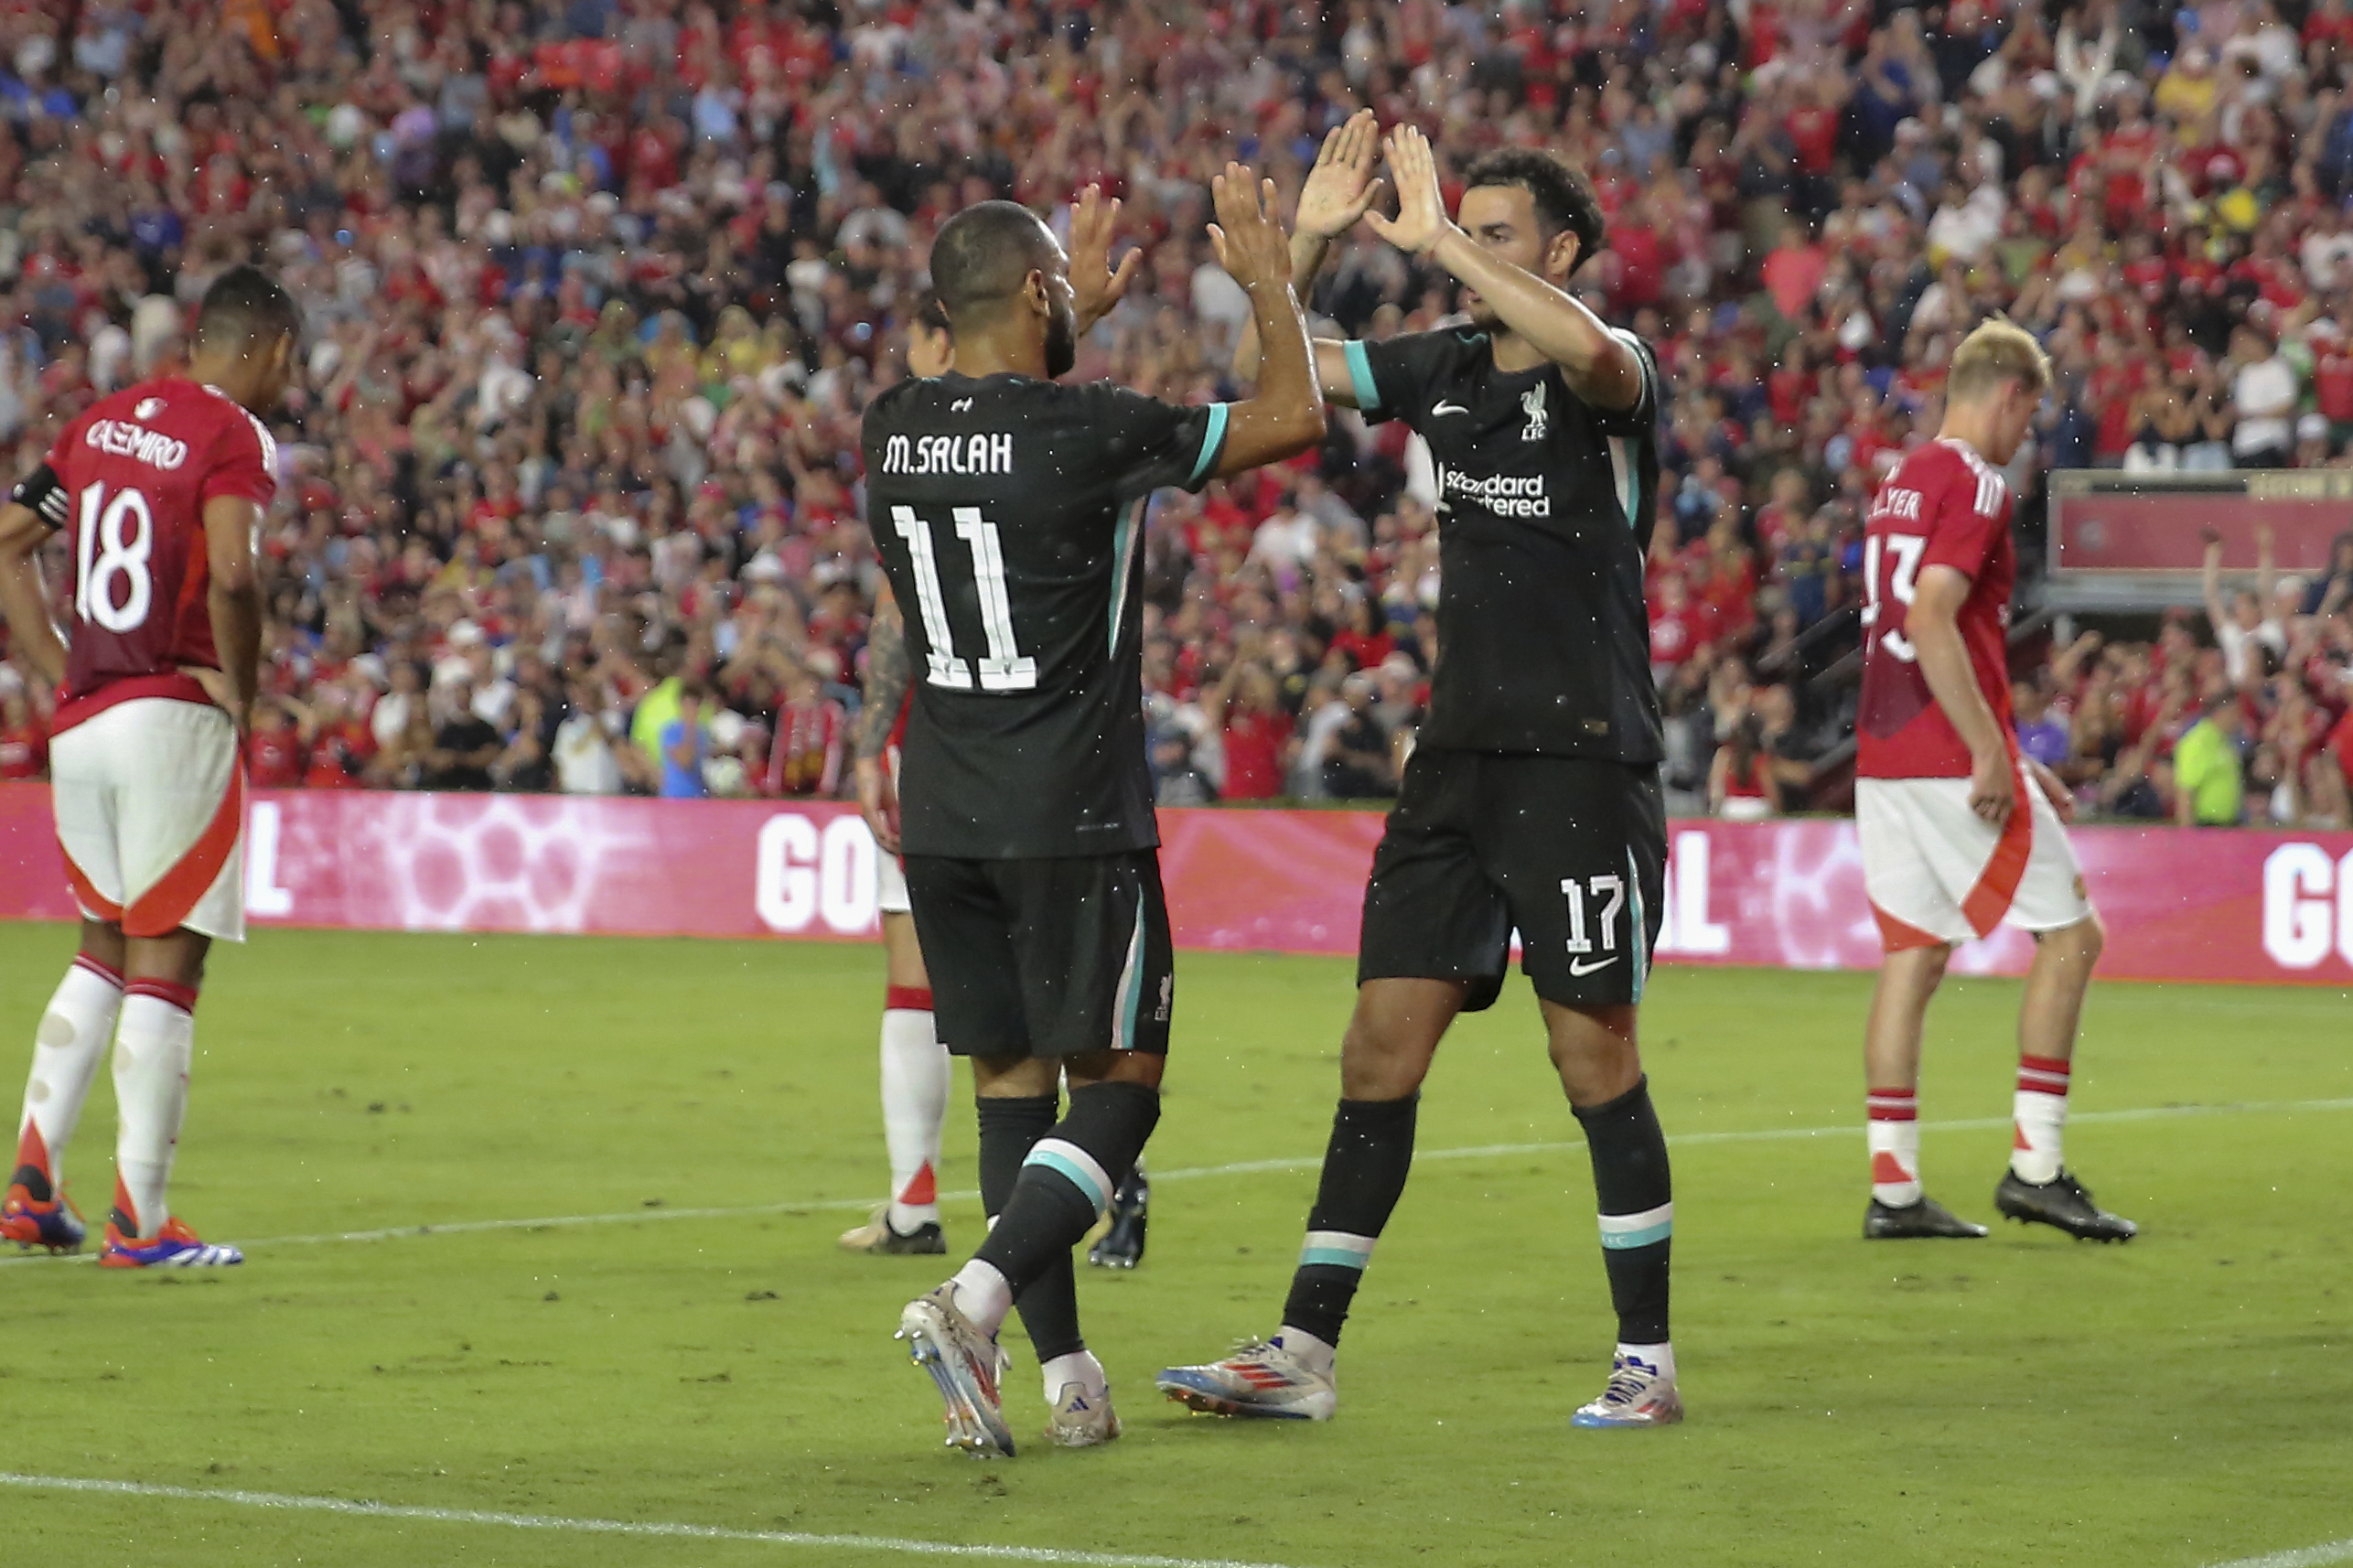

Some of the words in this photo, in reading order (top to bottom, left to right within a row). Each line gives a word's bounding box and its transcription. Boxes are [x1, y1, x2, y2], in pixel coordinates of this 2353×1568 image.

[883, 434, 1013, 476] M.SALAH
[75, 478, 154, 633] 18
[890, 505, 1038, 692] 11
[757, 813, 879, 935] GO
[1561, 875, 1625, 953] 17
[2262, 843, 2353, 970] G
